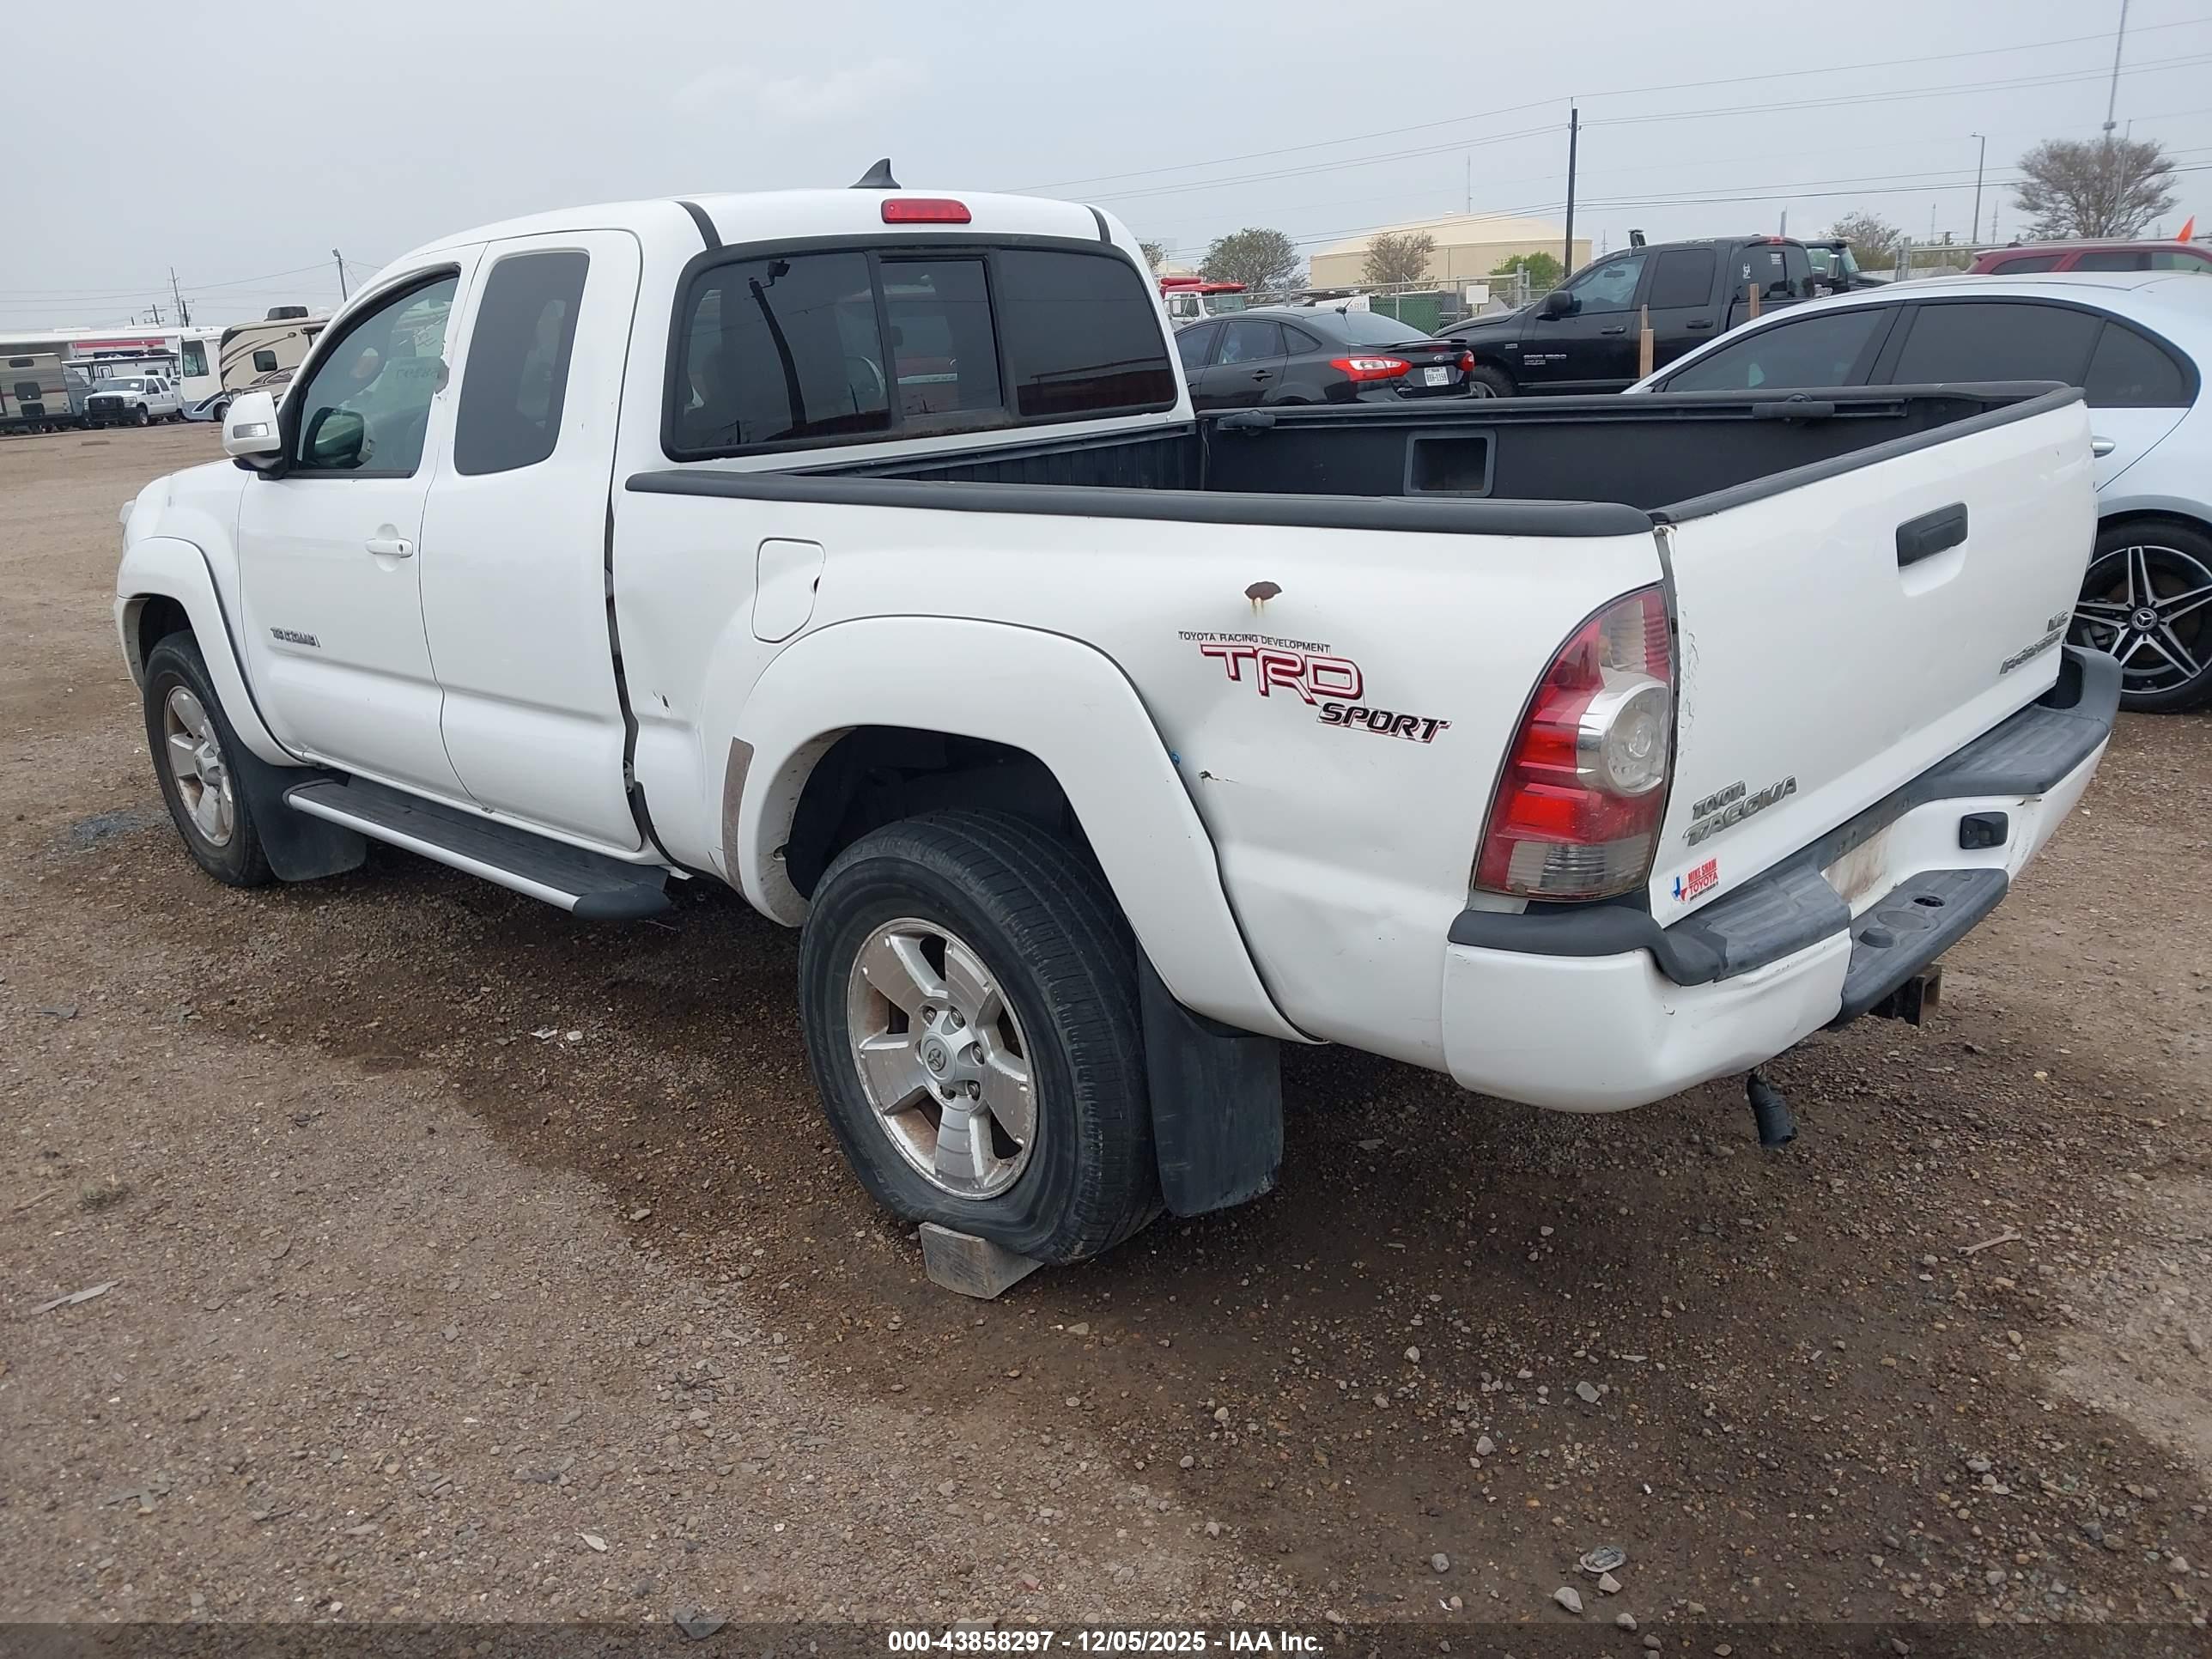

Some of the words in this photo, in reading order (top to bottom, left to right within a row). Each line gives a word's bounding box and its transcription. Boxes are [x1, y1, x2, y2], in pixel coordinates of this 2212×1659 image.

[1178, 631, 1216, 641] TOYOTA
[1219, 633, 1259, 643] RACING
[1261, 635, 1331, 653] DEVELOPMENT
[1200, 644, 1364, 706] TRD
[1316, 702, 1452, 744] SPORT
[1682, 775, 1797, 847] TACOMA
[1692, 780, 1747, 820] TOYOTA
[1688, 866, 1701, 883] MIKE
[1702, 858, 1717, 875] SHAW
[1689, 872, 1718, 895] TOYOTA
